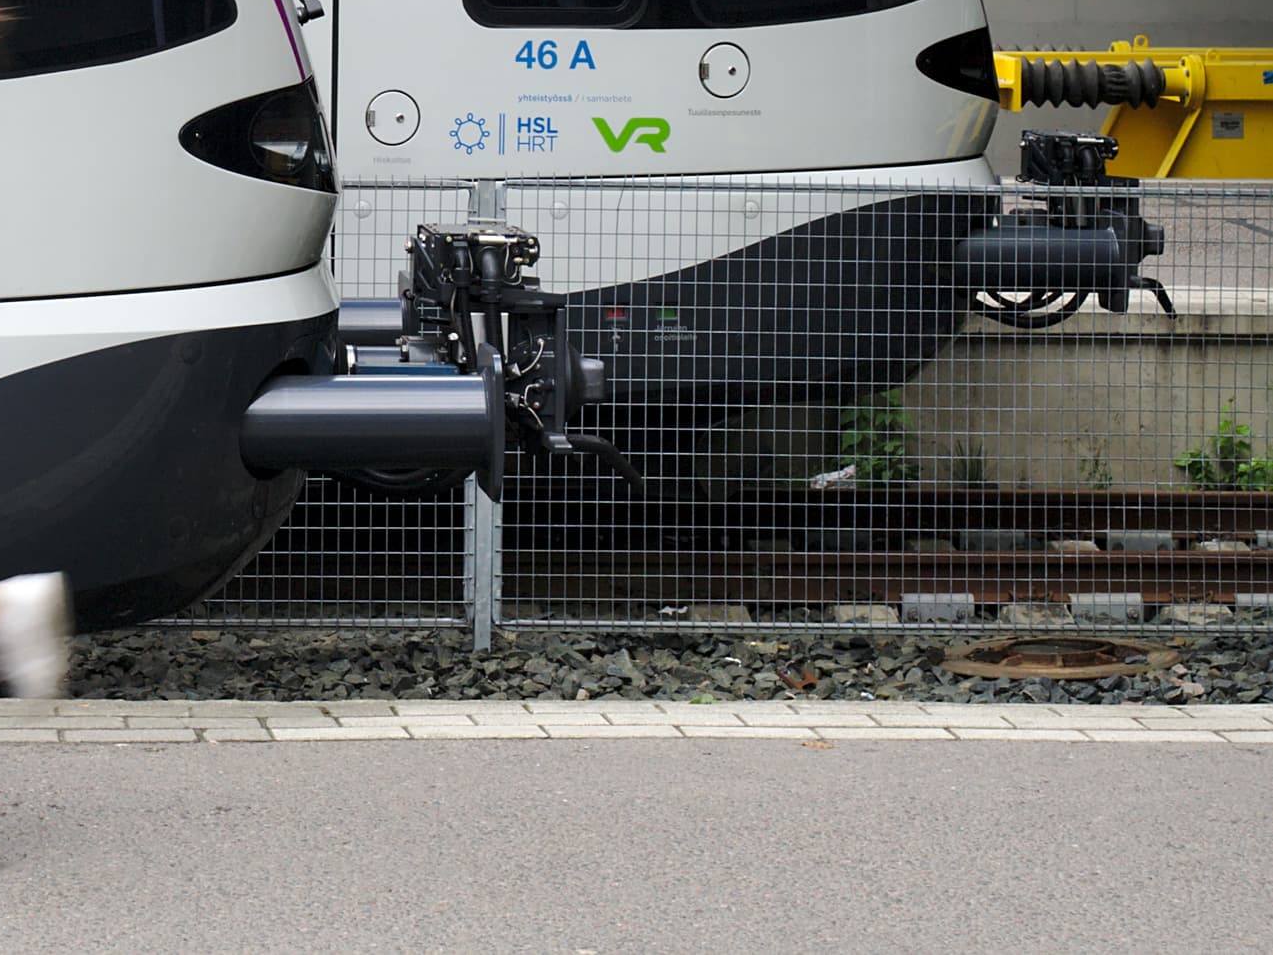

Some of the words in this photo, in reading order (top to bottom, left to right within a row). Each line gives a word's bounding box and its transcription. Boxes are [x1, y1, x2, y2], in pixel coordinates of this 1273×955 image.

[515, 40, 558, 70] 46
[569, 40, 596, 70] A
[517, 117, 559, 134] HSL
[591, 117, 671, 153] VR
[517, 135, 559, 152] HRT
